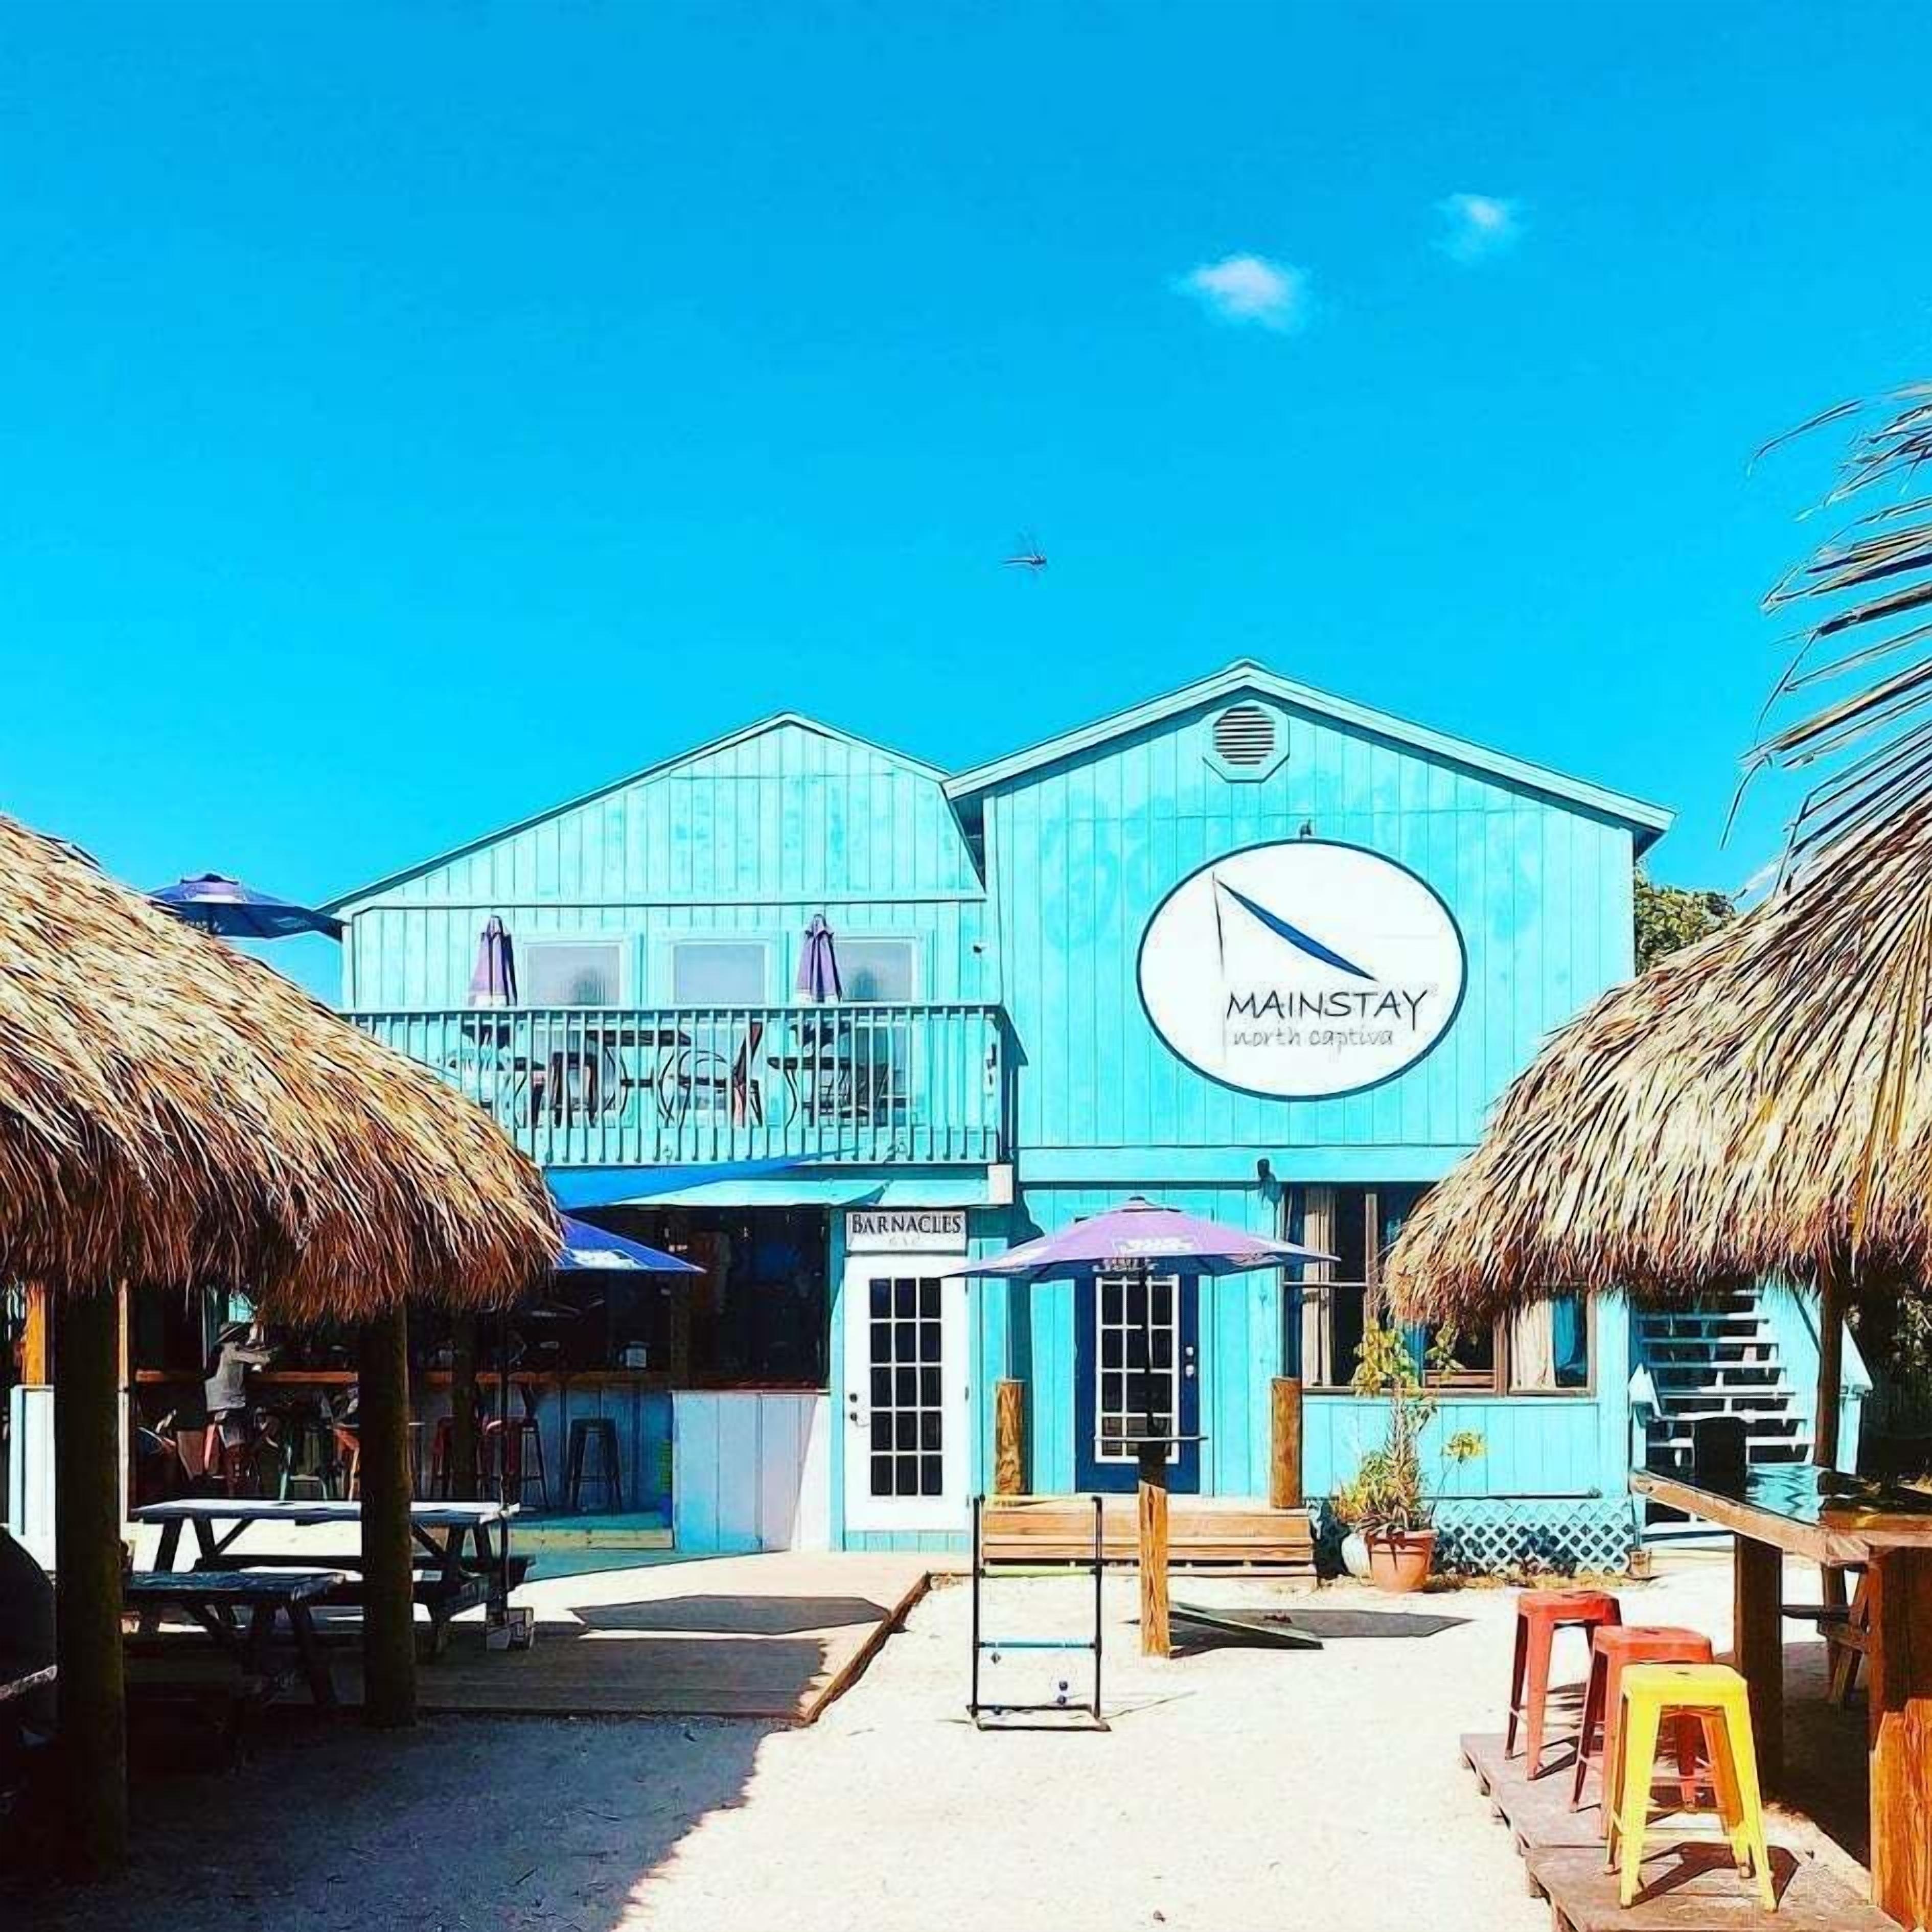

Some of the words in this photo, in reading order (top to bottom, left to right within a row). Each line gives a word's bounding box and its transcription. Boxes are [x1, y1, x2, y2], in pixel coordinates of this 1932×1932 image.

[1226, 990, 1428, 1031] MAINSTAY
[1233, 1027, 1301, 1046] north
[1308, 1027, 1393, 1054] captiva
[852, 1213, 961, 1234] BARNACLES
